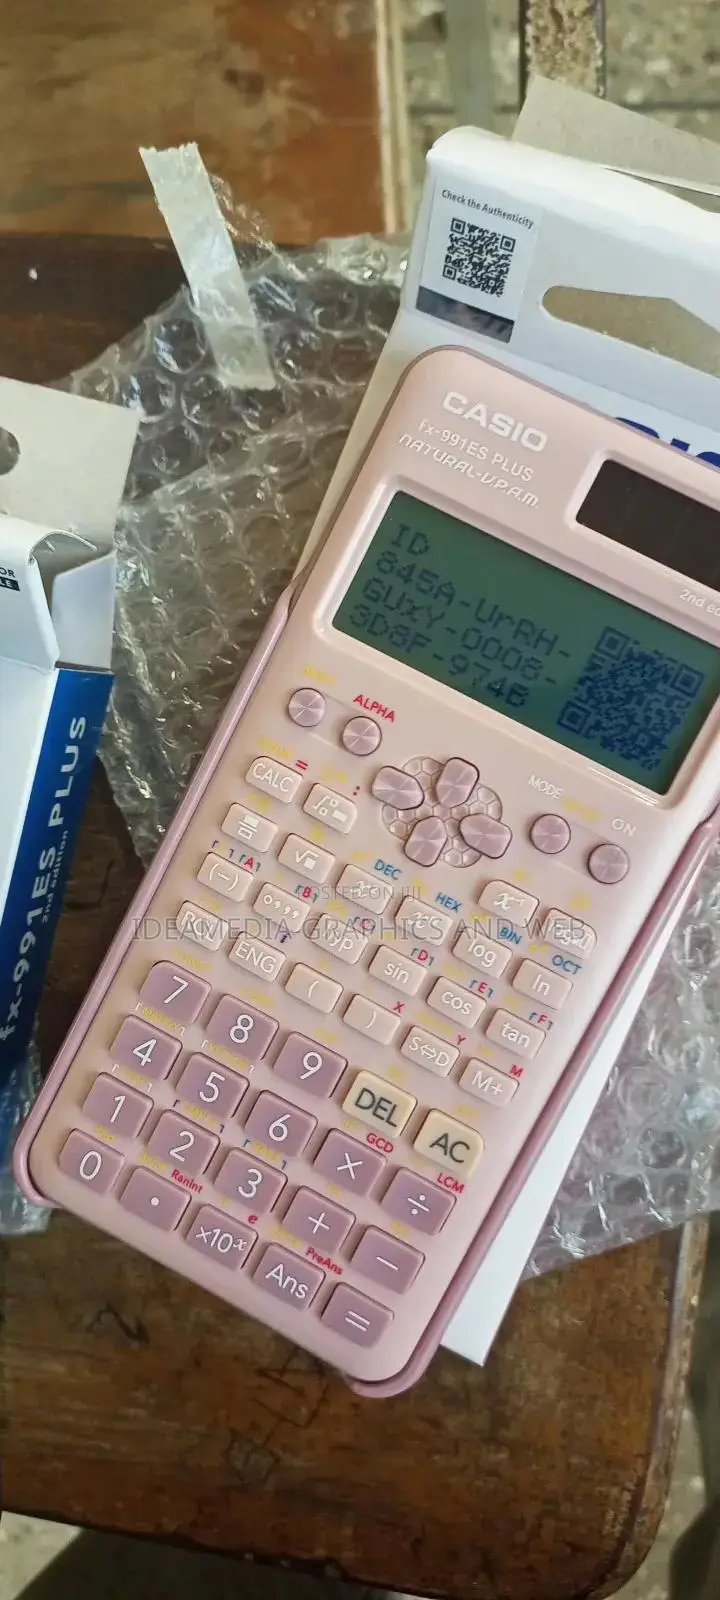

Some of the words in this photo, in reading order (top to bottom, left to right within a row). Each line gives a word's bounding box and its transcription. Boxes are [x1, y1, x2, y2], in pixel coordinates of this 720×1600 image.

[442, 190, 465, 204] Check
[468, 198, 480, 210] the
[482, 204, 534, 230] Authenticity
[442, 391, 547, 452] CASIO
[419, 419, 488, 460] fx-991ES
[492, 452, 534, 481] PLUS
[391, 523, 430, 556] ID
[680, 589, 707, 607] 2nd
[353, 694, 397, 722] ALPHA
[48, 716, 85, 828] PLUS
[253, 763, 293, 792] CALC
[528, 775, 563, 800] MODE
[611, 818, 637, 836] ON
[375, 859, 402, 880] DEC
[435, 891, 463, 913] HEX
[500, 927, 522, 944] BIN
[235, 943, 276, 973] ENG
[468, 940, 497, 968] log
[552, 954, 582, 975] OCT
[384, 963, 410, 984] sin
[164, 976, 189, 1004] 7
[441, 991, 472, 1015] cos
[229, 1014, 254, 1044] 8
[501, 1021, 530, 1048] tan
[132, 1038, 157, 1066] 4
[300, 1051, 323, 1080] 9
[472, 1070, 502, 1095] M+
[510, 1064, 524, 1078] M
[199, 1071, 226, 1103] 5
[110, 1095, 126, 1123] 1
[354, 1088, 397, 1128] DEL
[268, 1113, 291, 1142] 6
[169, 1130, 195, 1162] 2
[366, 1132, 394, 1153] GCD
[429, 1132, 470, 1164] AC
[79, 1150, 102, 1180] 0
[238, 1168, 263, 1198] 3
[436, 1172, 465, 1193] LCM
[248, 1215, 258, 1224] e
[306, 1246, 343, 1275] PreAns
[265, 1263, 309, 1299] Ans
